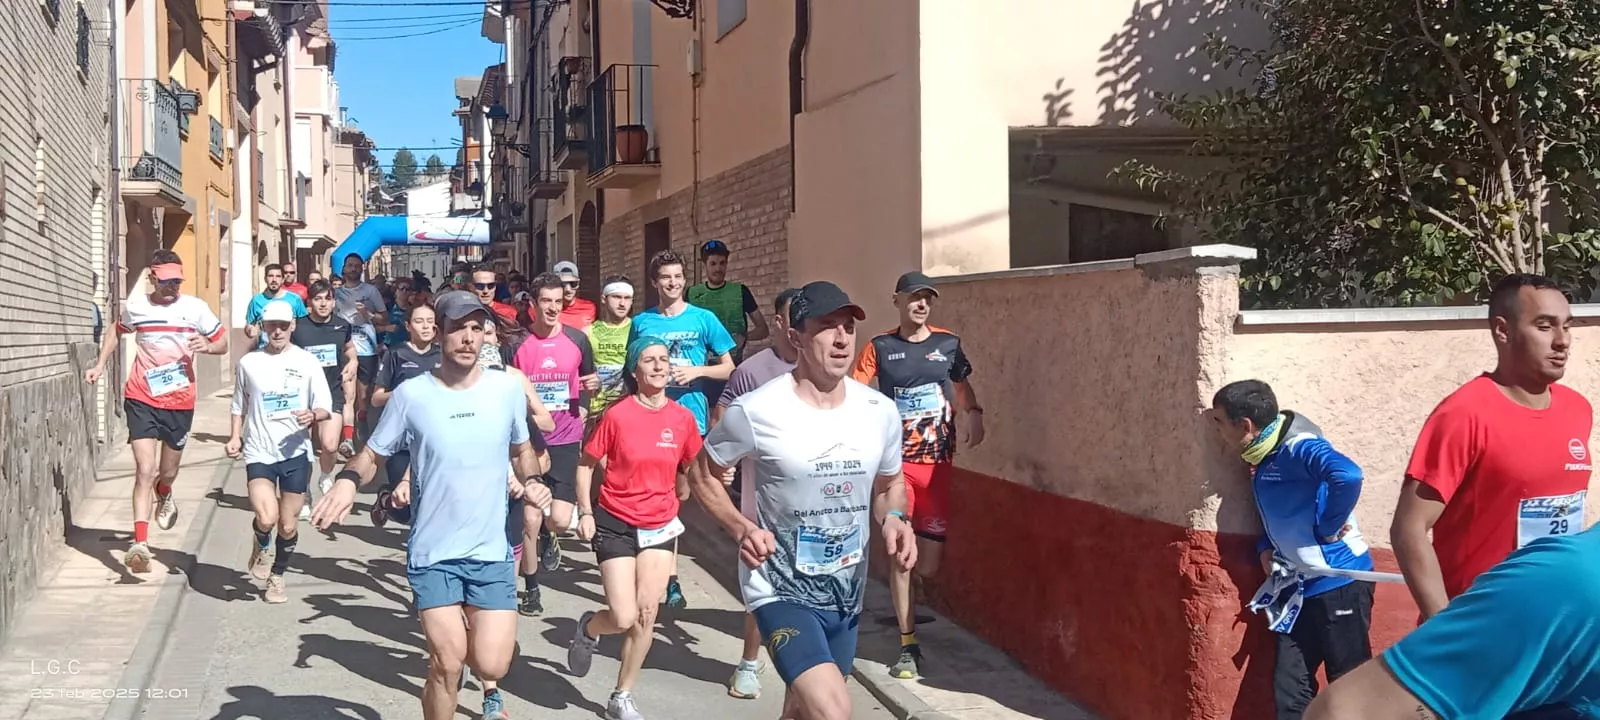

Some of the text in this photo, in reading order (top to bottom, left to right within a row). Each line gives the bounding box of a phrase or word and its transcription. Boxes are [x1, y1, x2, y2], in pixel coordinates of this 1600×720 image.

[161, 374, 173, 383] 20
[543, 393, 555, 401] 42
[276, 400, 288, 408] 72
[909, 398, 922, 408] 37
[815, 459, 862, 471] 1949 2024
[793, 509, 808, 518] Del
[1548, 519, 1569, 535] 29
[823, 544, 844, 558] 58
